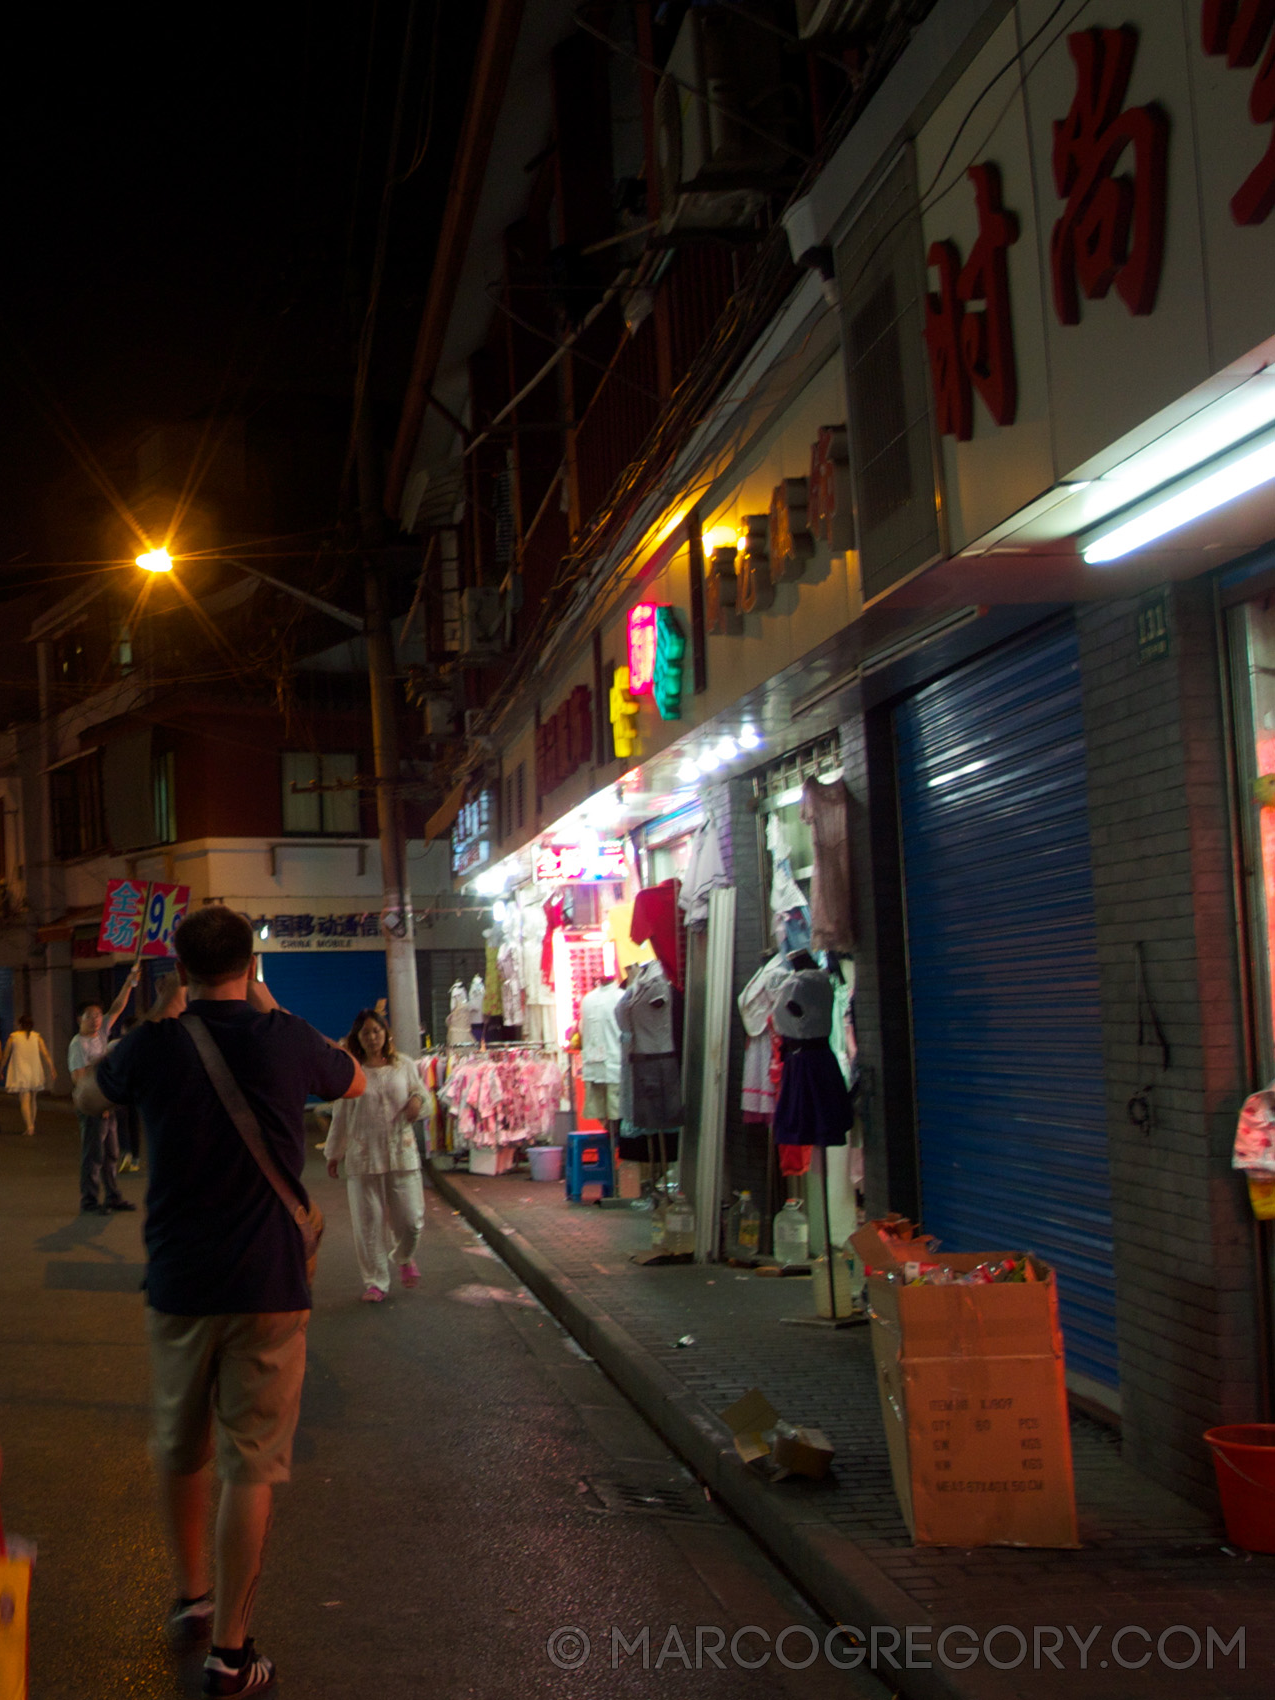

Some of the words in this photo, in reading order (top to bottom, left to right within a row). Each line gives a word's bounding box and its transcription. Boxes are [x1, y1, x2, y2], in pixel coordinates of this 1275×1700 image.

[104, 882, 141, 948] 全场
[253, 913, 380, 938] 中国移动通信
[280, 939, 312, 949] CHINA
[316, 939, 353, 949] MOBILE
